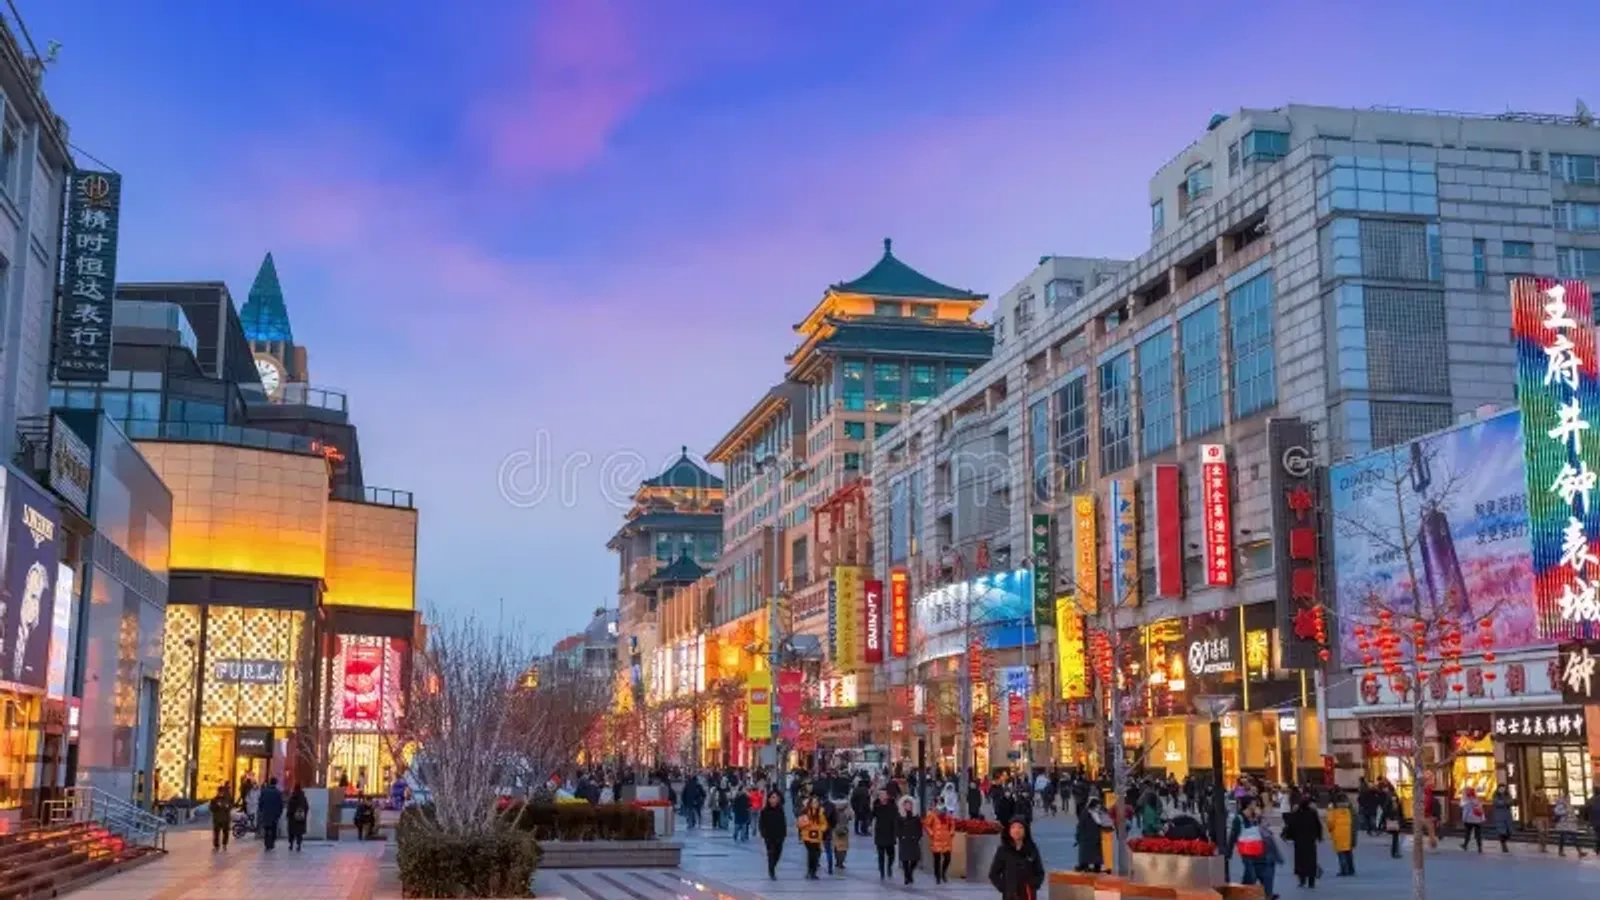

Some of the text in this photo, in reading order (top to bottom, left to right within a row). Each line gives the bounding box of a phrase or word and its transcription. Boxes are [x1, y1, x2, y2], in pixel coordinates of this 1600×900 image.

[1542, 284, 1600, 625] 王府井钟表城
[214, 662, 281, 680] FURLA
[1562, 648, 1596, 697] 钟
[1496, 713, 1583, 736] 瑞士名表维修中
